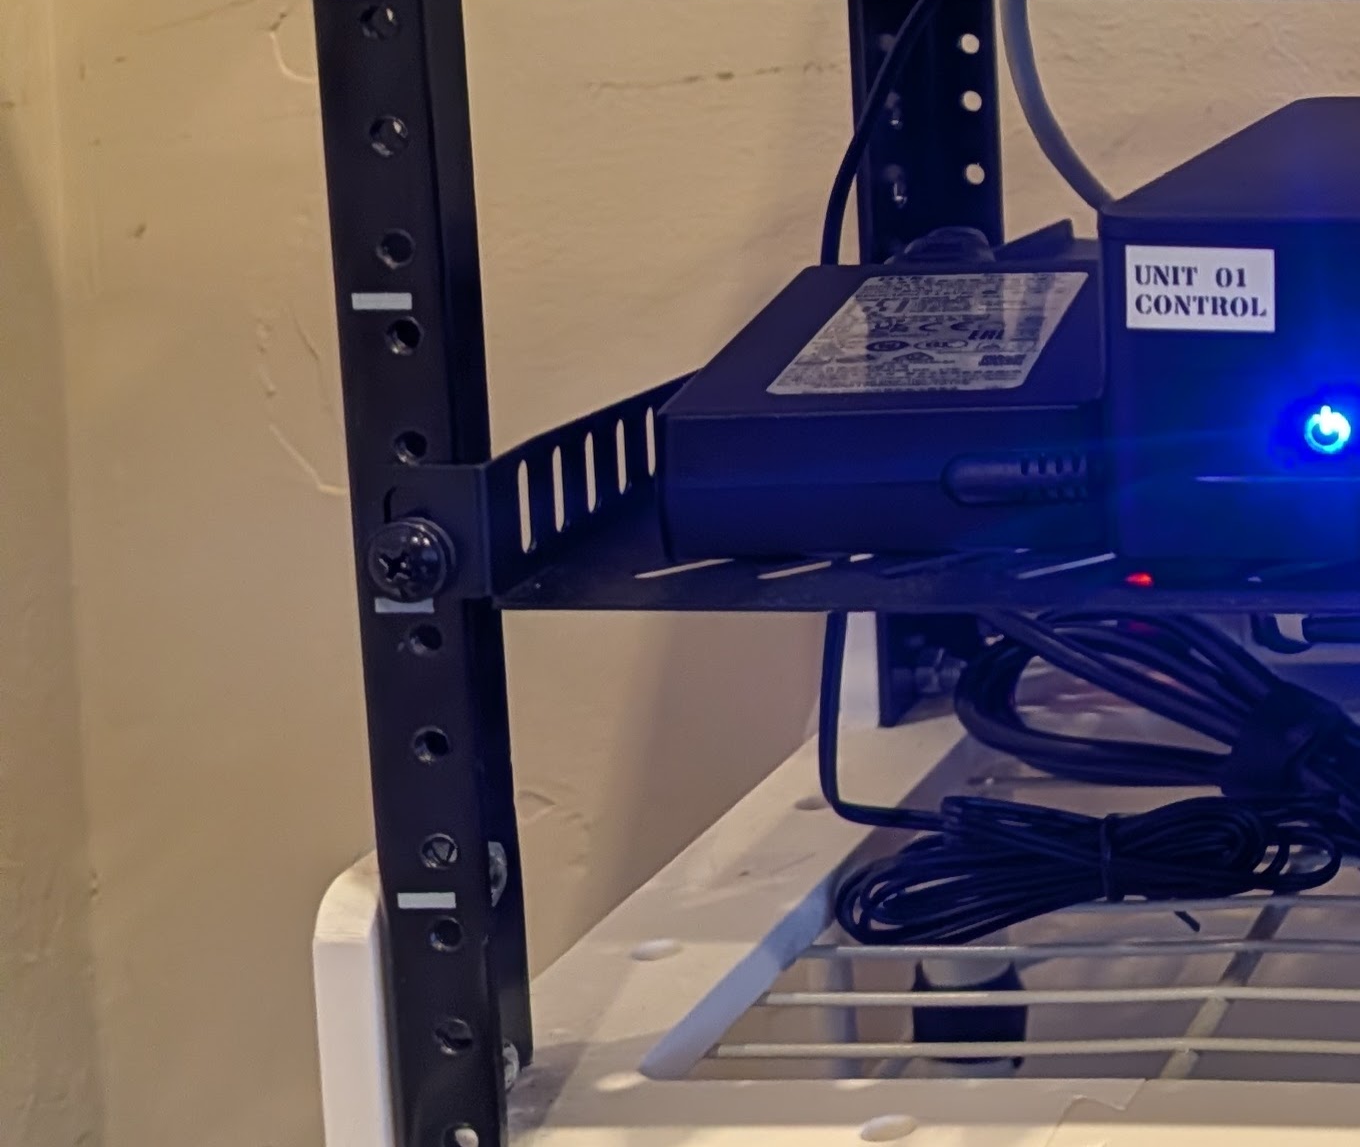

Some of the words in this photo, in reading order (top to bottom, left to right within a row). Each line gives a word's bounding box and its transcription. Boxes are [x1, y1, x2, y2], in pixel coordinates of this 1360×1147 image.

[1134, 264, 1198, 286] UNIT
[1215, 267, 1246, 288] 01
[1135, 294, 1267, 317] CONTROL
